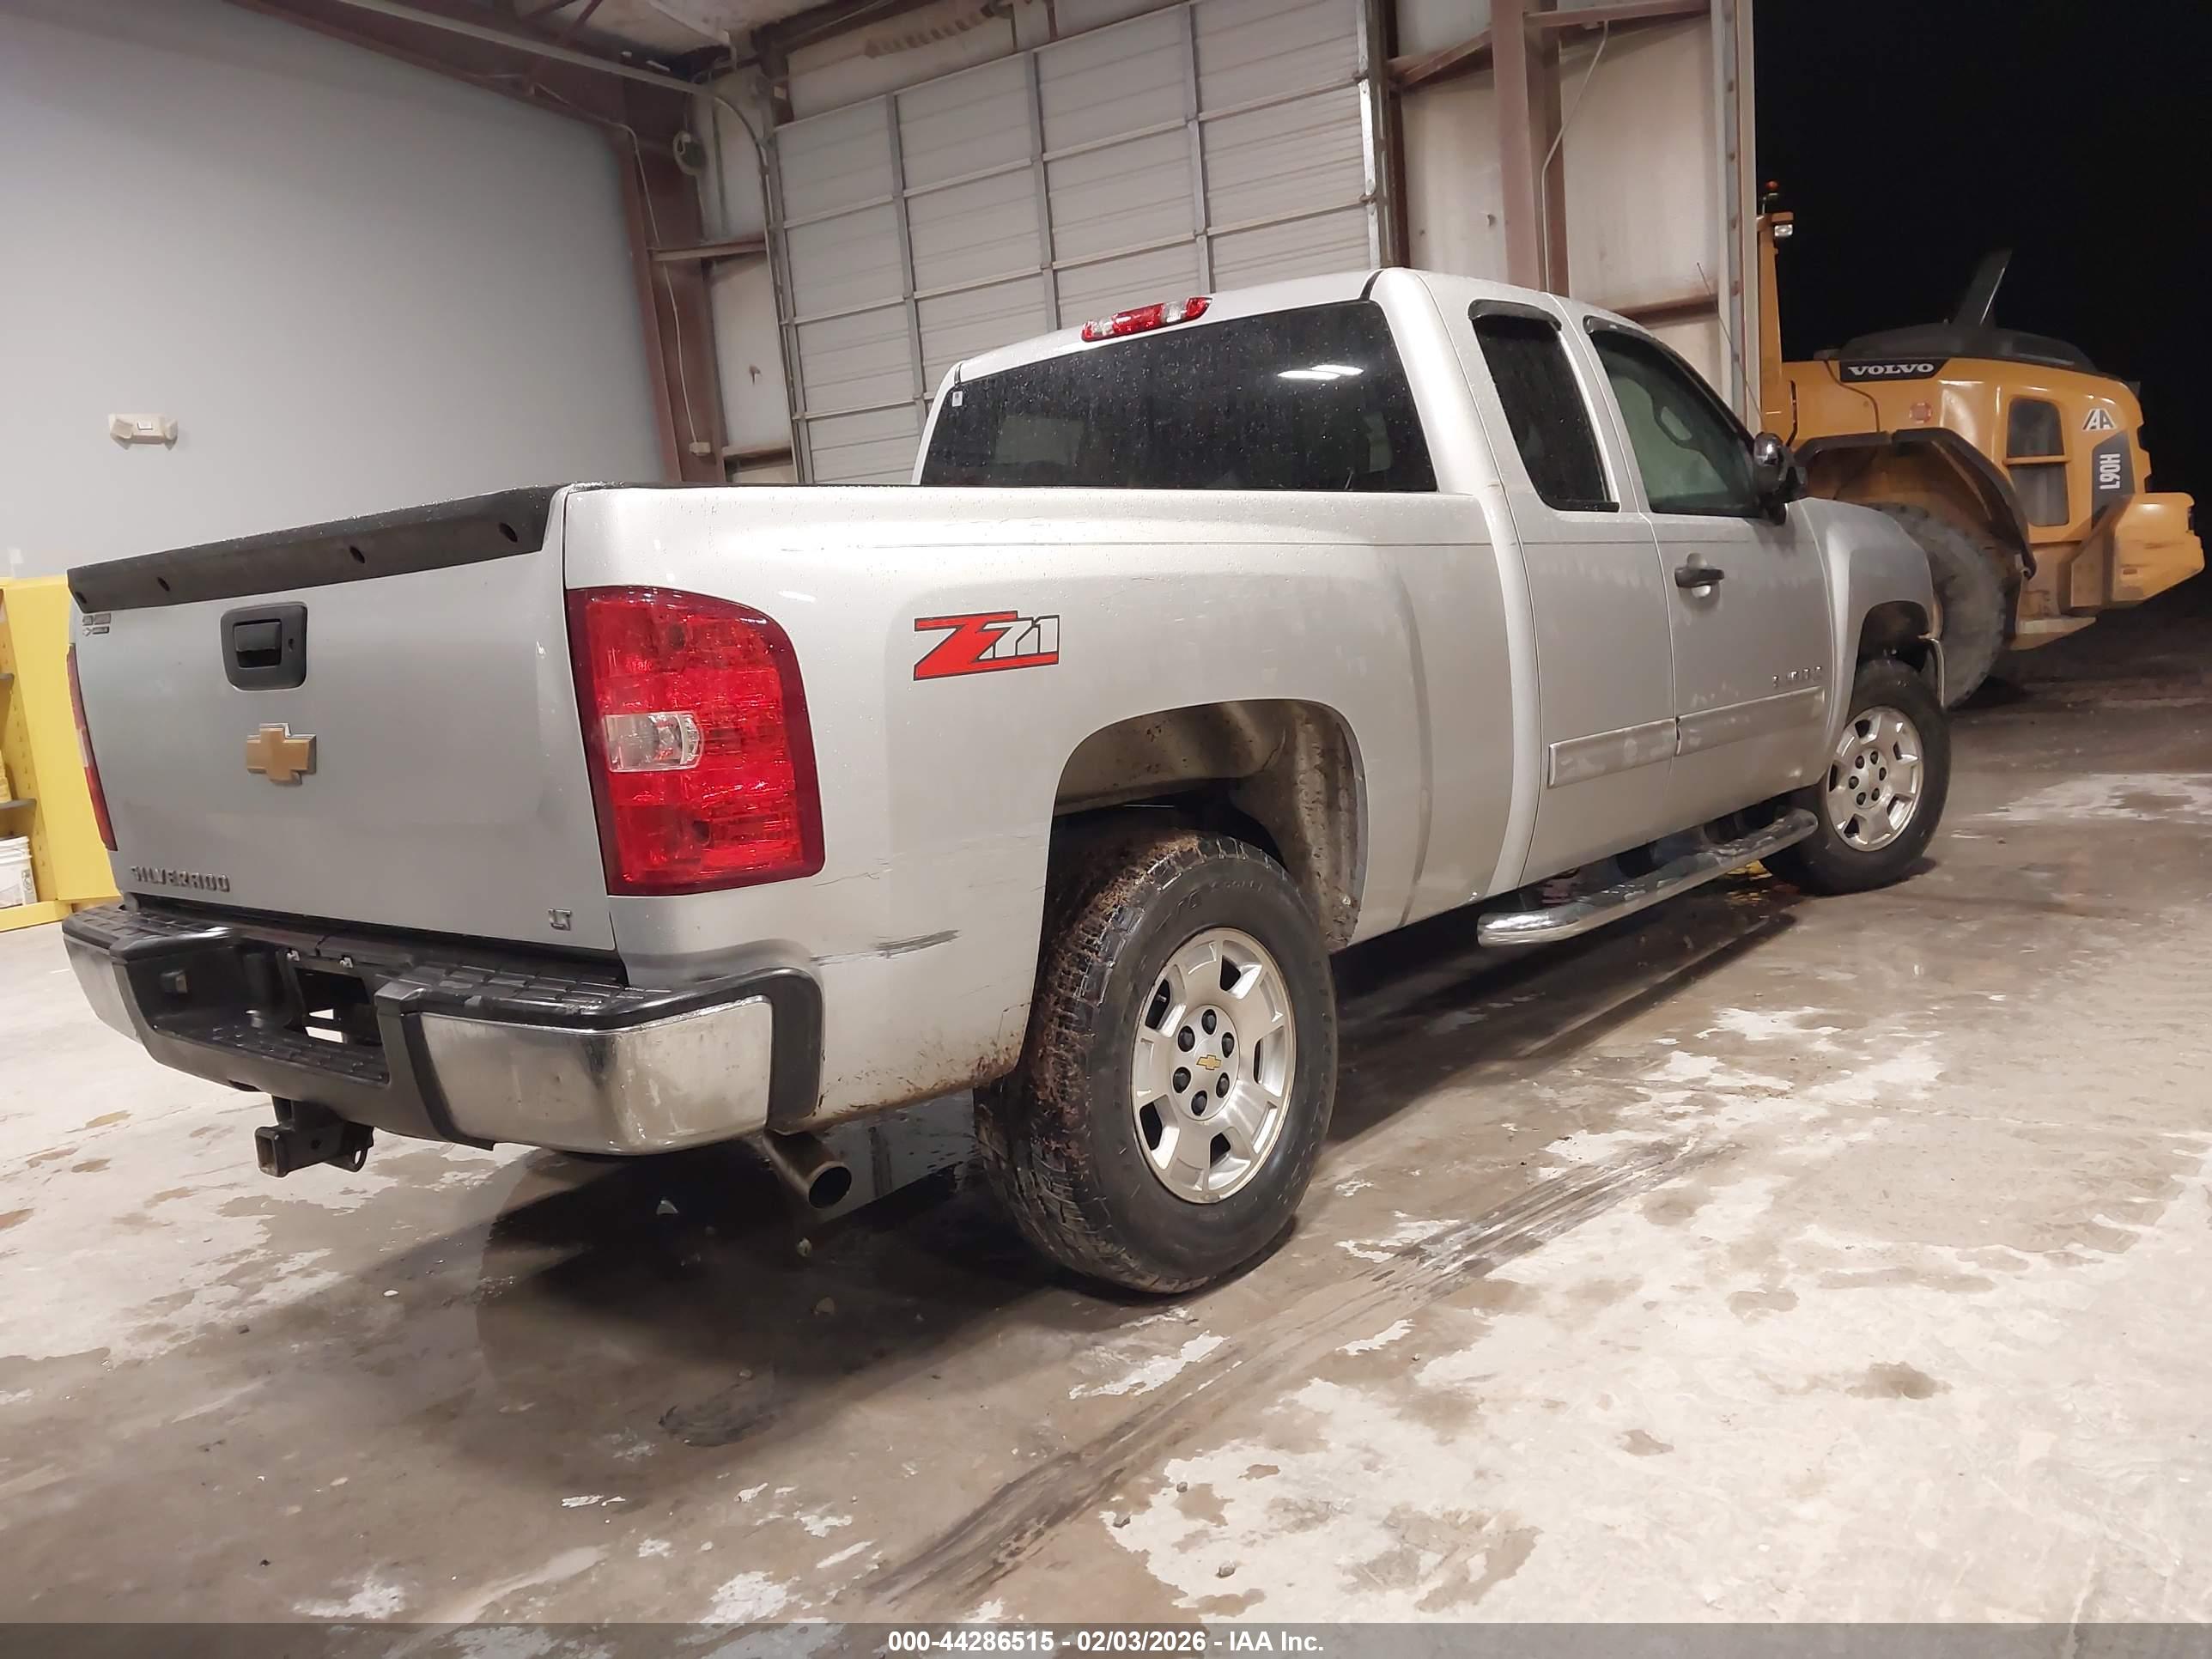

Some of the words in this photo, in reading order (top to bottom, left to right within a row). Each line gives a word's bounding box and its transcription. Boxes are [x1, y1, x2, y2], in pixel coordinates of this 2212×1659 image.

[1848, 363, 1934, 376] VOLVO
[2100, 453, 2121, 489] L90H
[914, 610, 1060, 681] Z71
[549, 908, 572, 931] LT
